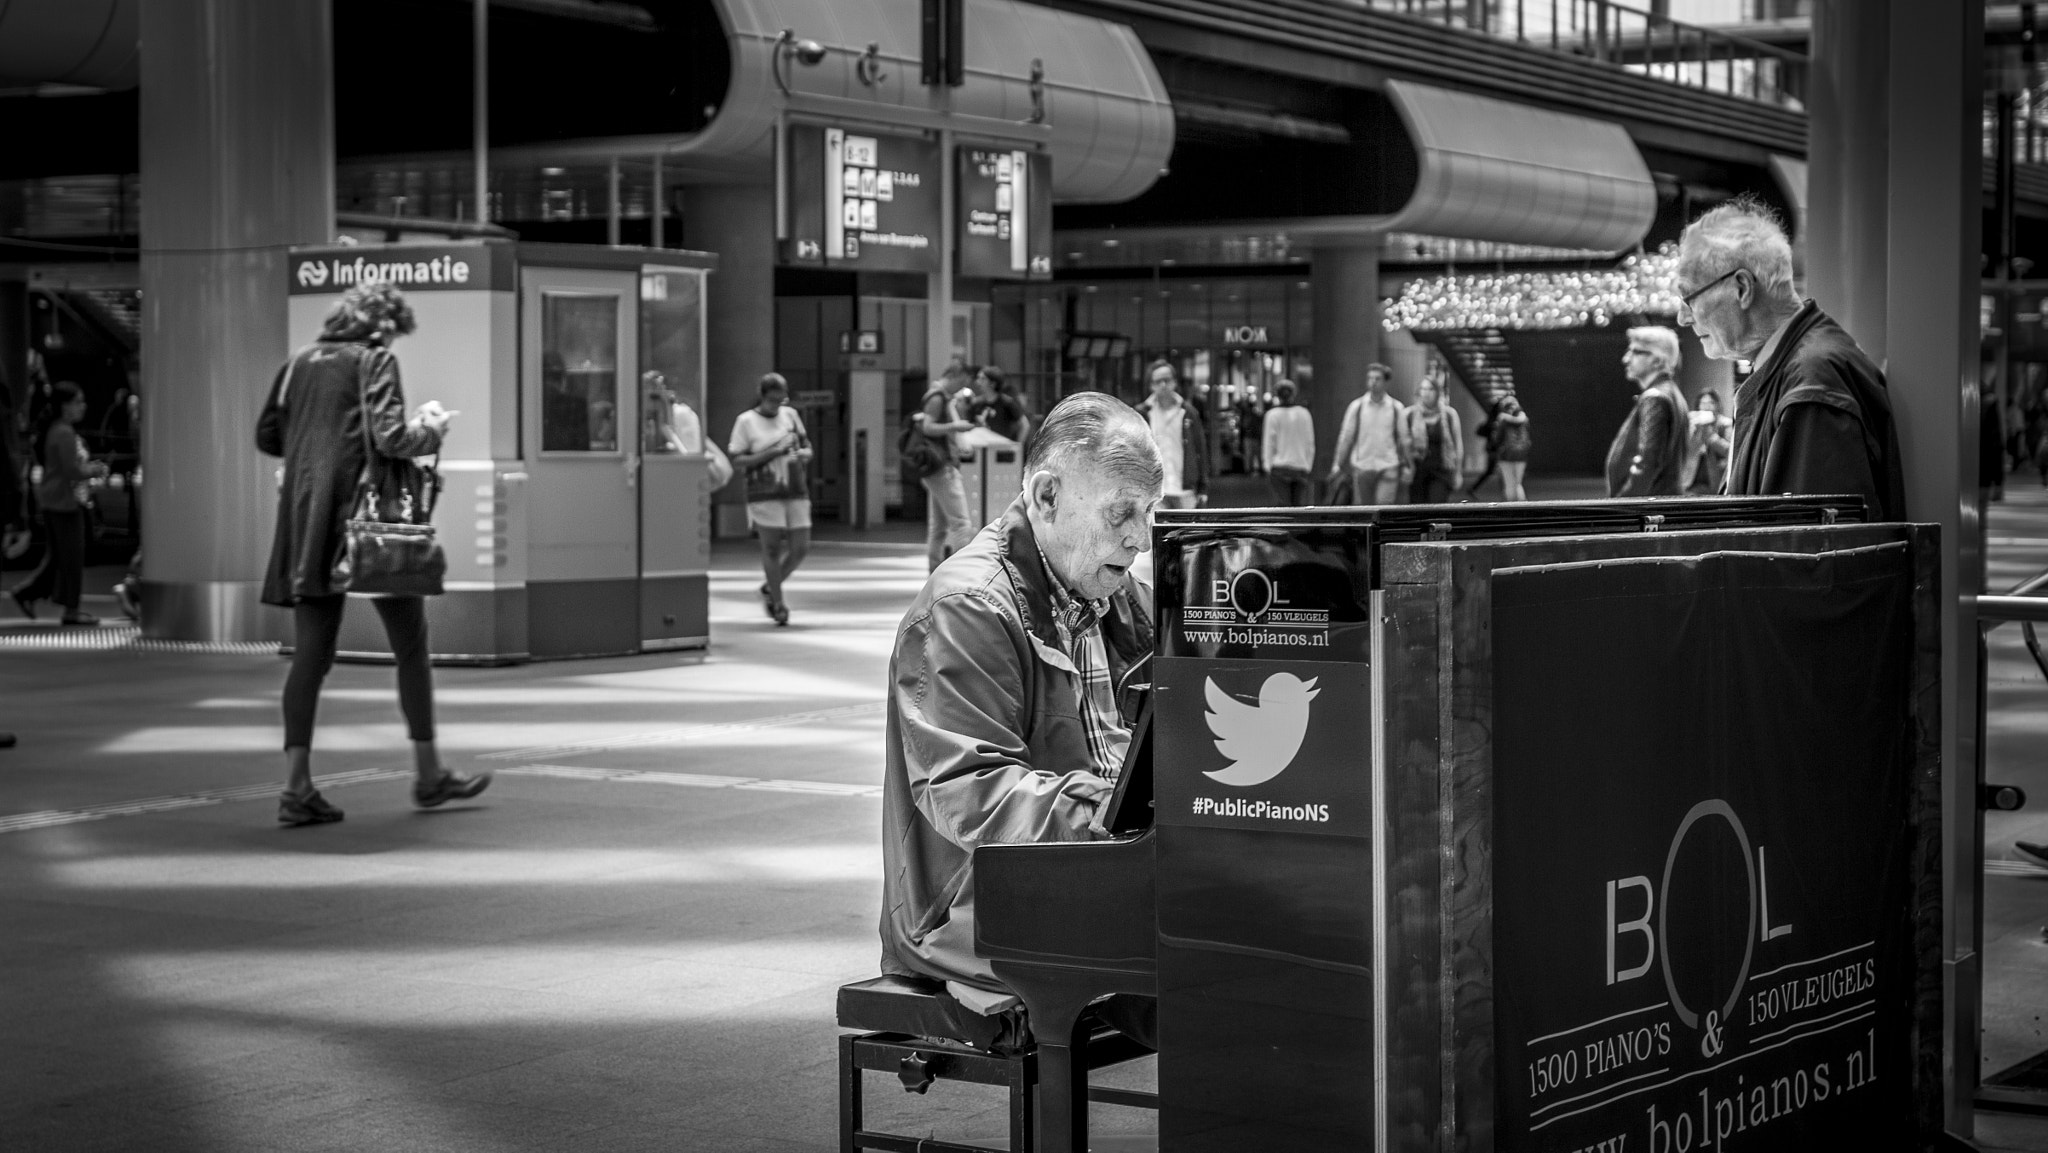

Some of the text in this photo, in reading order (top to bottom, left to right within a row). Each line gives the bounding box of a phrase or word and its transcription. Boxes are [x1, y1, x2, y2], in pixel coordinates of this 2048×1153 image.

[332, 255, 470, 285] Informatie
[1212, 568, 1290, 617] BOL
[1183, 610, 1329, 624] 1500 PIANO'S & 150 VLEUGELS
[1183, 627, 1330, 649] www.bolpianos.nl
[1192, 797, 1330, 823] #PublicPianoNS
[1606, 798, 1793, 1030] BOL
[1529, 1049, 1578, 1098] 1500
[1585, 1021, 1672, 1080] PIANO'S
[1701, 1010, 1725, 1058] &
[1571, 1028, 1878, 1153] bolpianos.nl
